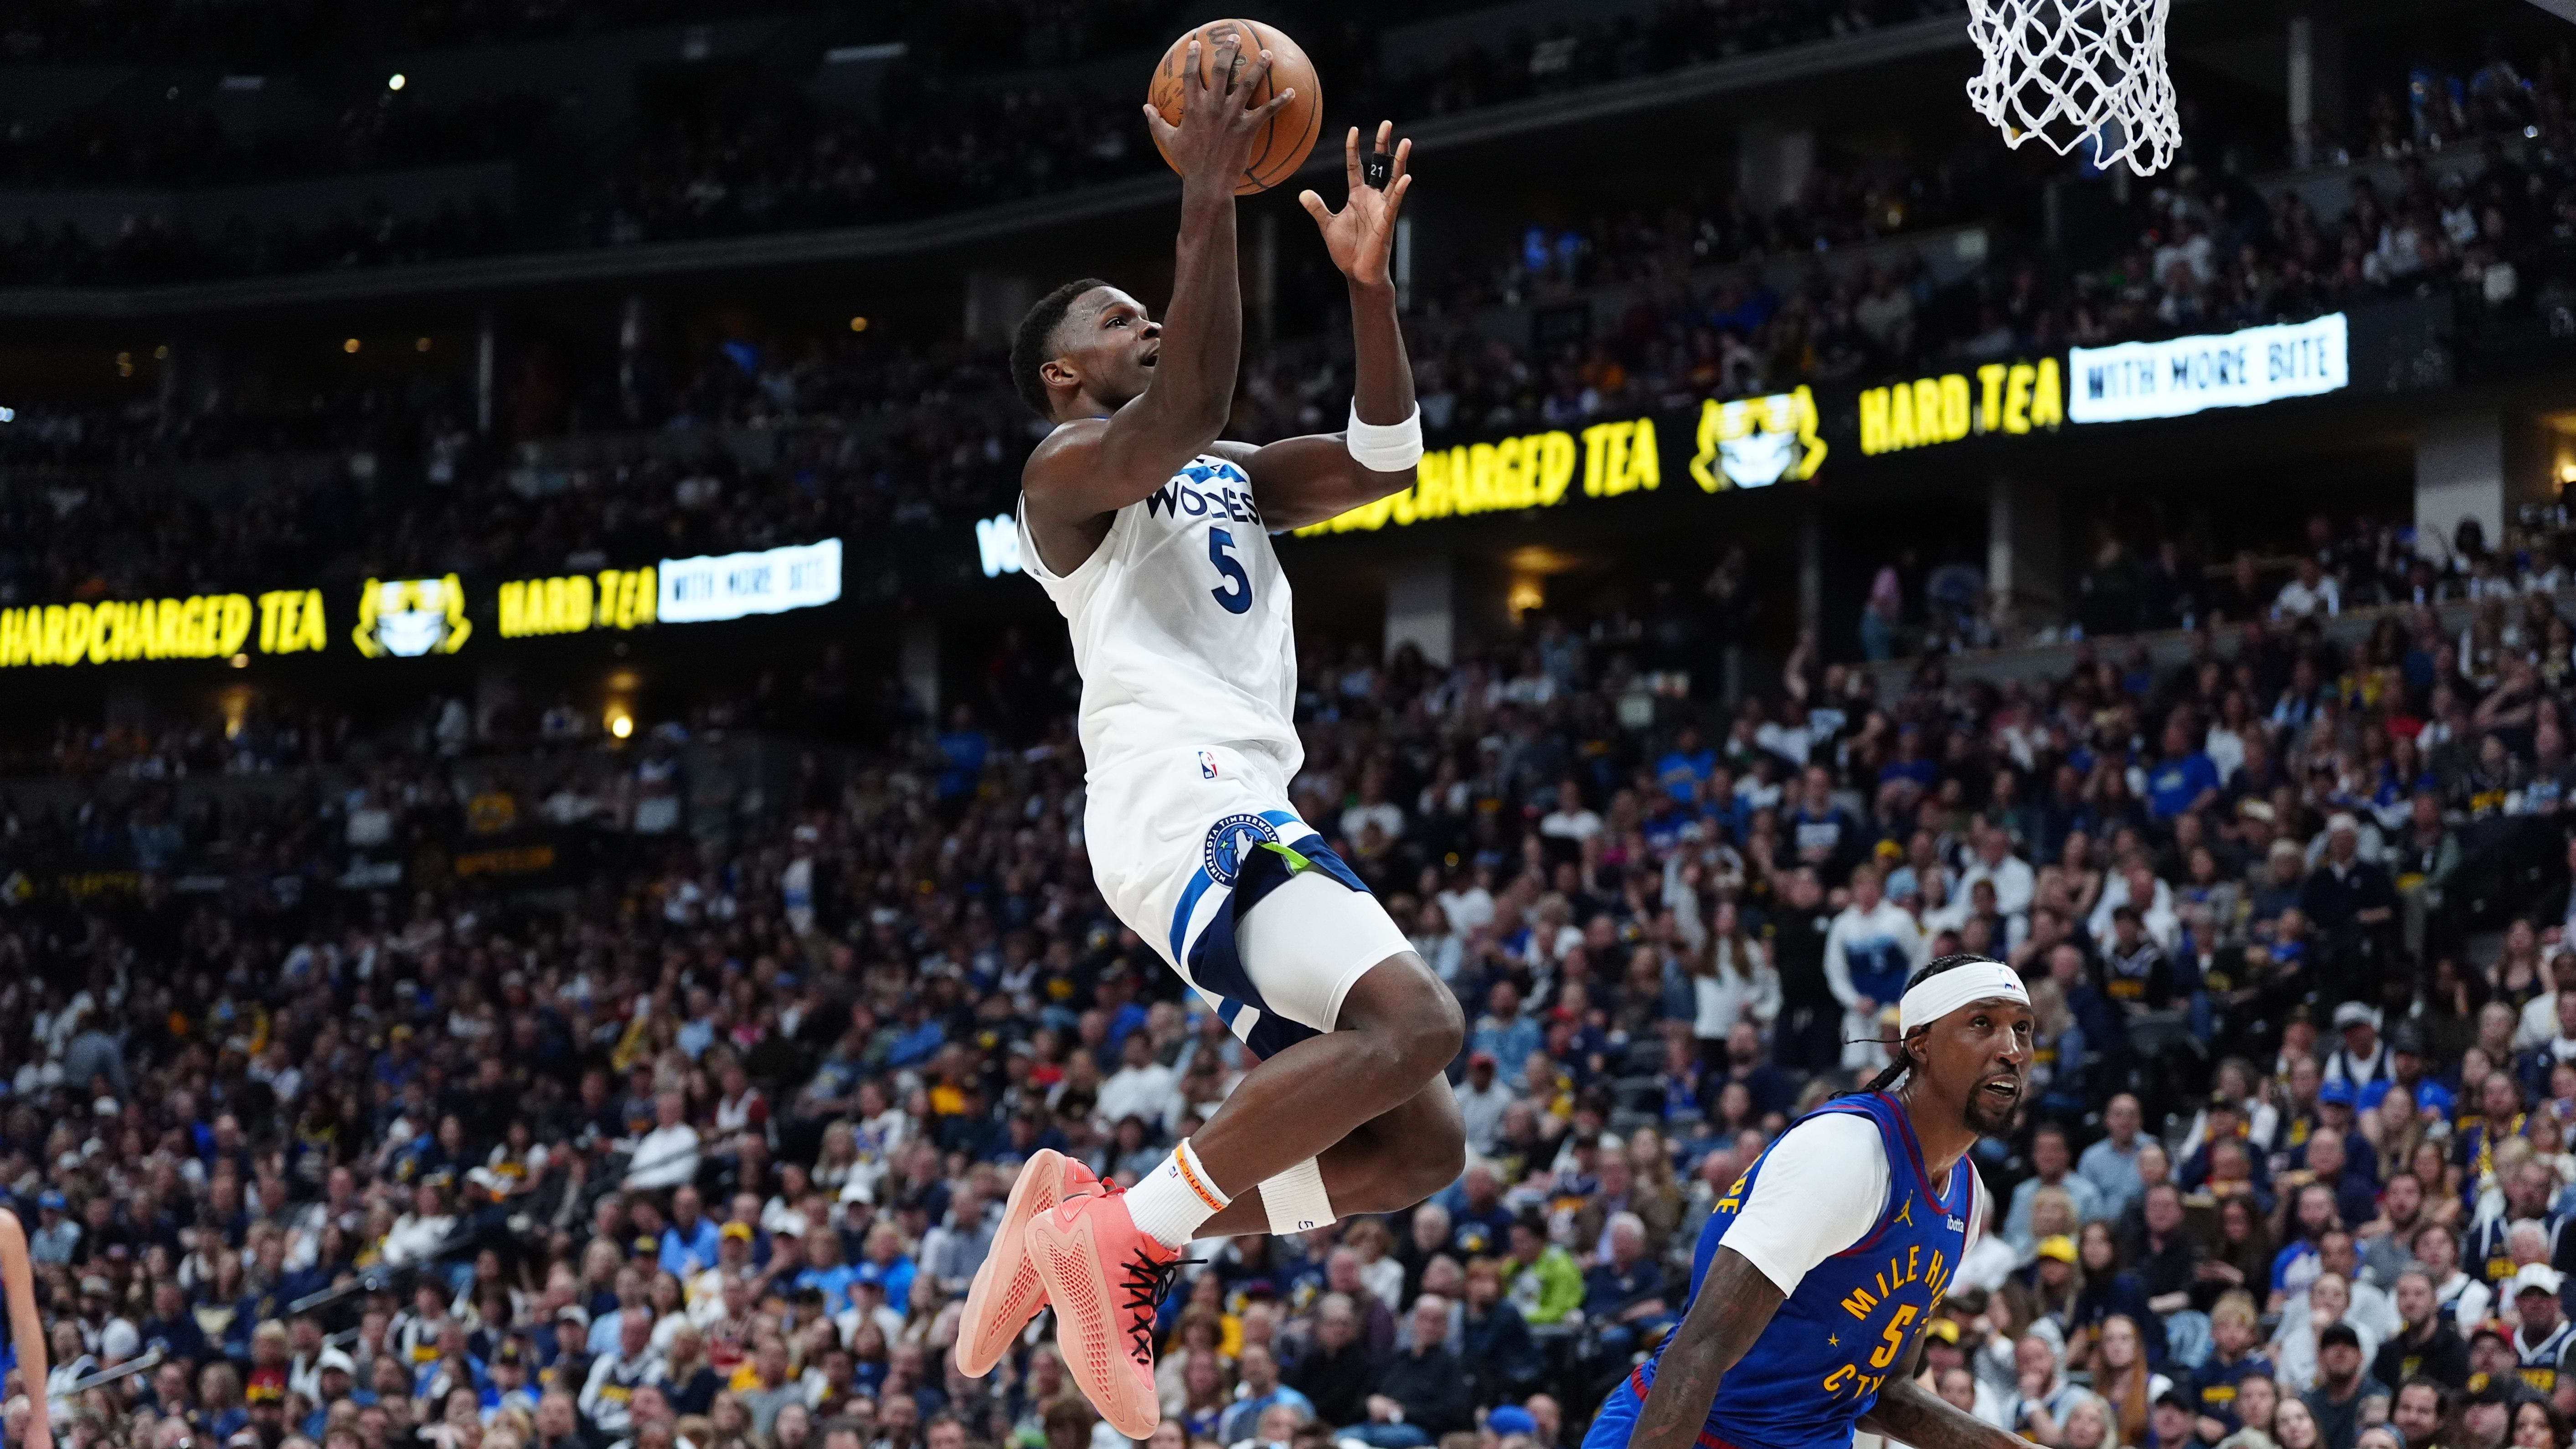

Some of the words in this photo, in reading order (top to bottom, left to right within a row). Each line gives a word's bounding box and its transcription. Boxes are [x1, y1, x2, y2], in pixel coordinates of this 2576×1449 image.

[1370, 164, 1383, 178] 21
[2088, 361, 2153, 400] WITH
[2172, 345, 2246, 391] MORE
[2268, 334, 2329, 380] BITE
[1859, 373, 1970, 456] HARD
[1978, 356, 2063, 434] TEA
[1581, 417, 1660, 498] TEA
[498, 575, 592, 638] HARD
[596, 566, 658, 630] TEA
[674, 571, 713, 601] WITH
[726, 565, 772, 594] MORE
[1210, 526, 1252, 614] 5
[0, 593, 252, 667] HARDCHARGED
[258, 588, 326, 654] TEA
[1206, 829, 1226, 883] MINNESOTA
[1219, 815, 1278, 842] TIMBERWOLV
[1179, 1158, 1221, 1210] THENTICS
[1298, 1221, 1314, 1229] 5
[1947, 1214, 1964, 1233] ibotta
[1841, 1245, 1920, 1321] MILE
[1869, 1304, 1919, 1369] 5
[1824, 1363, 1886, 1400] CTY
